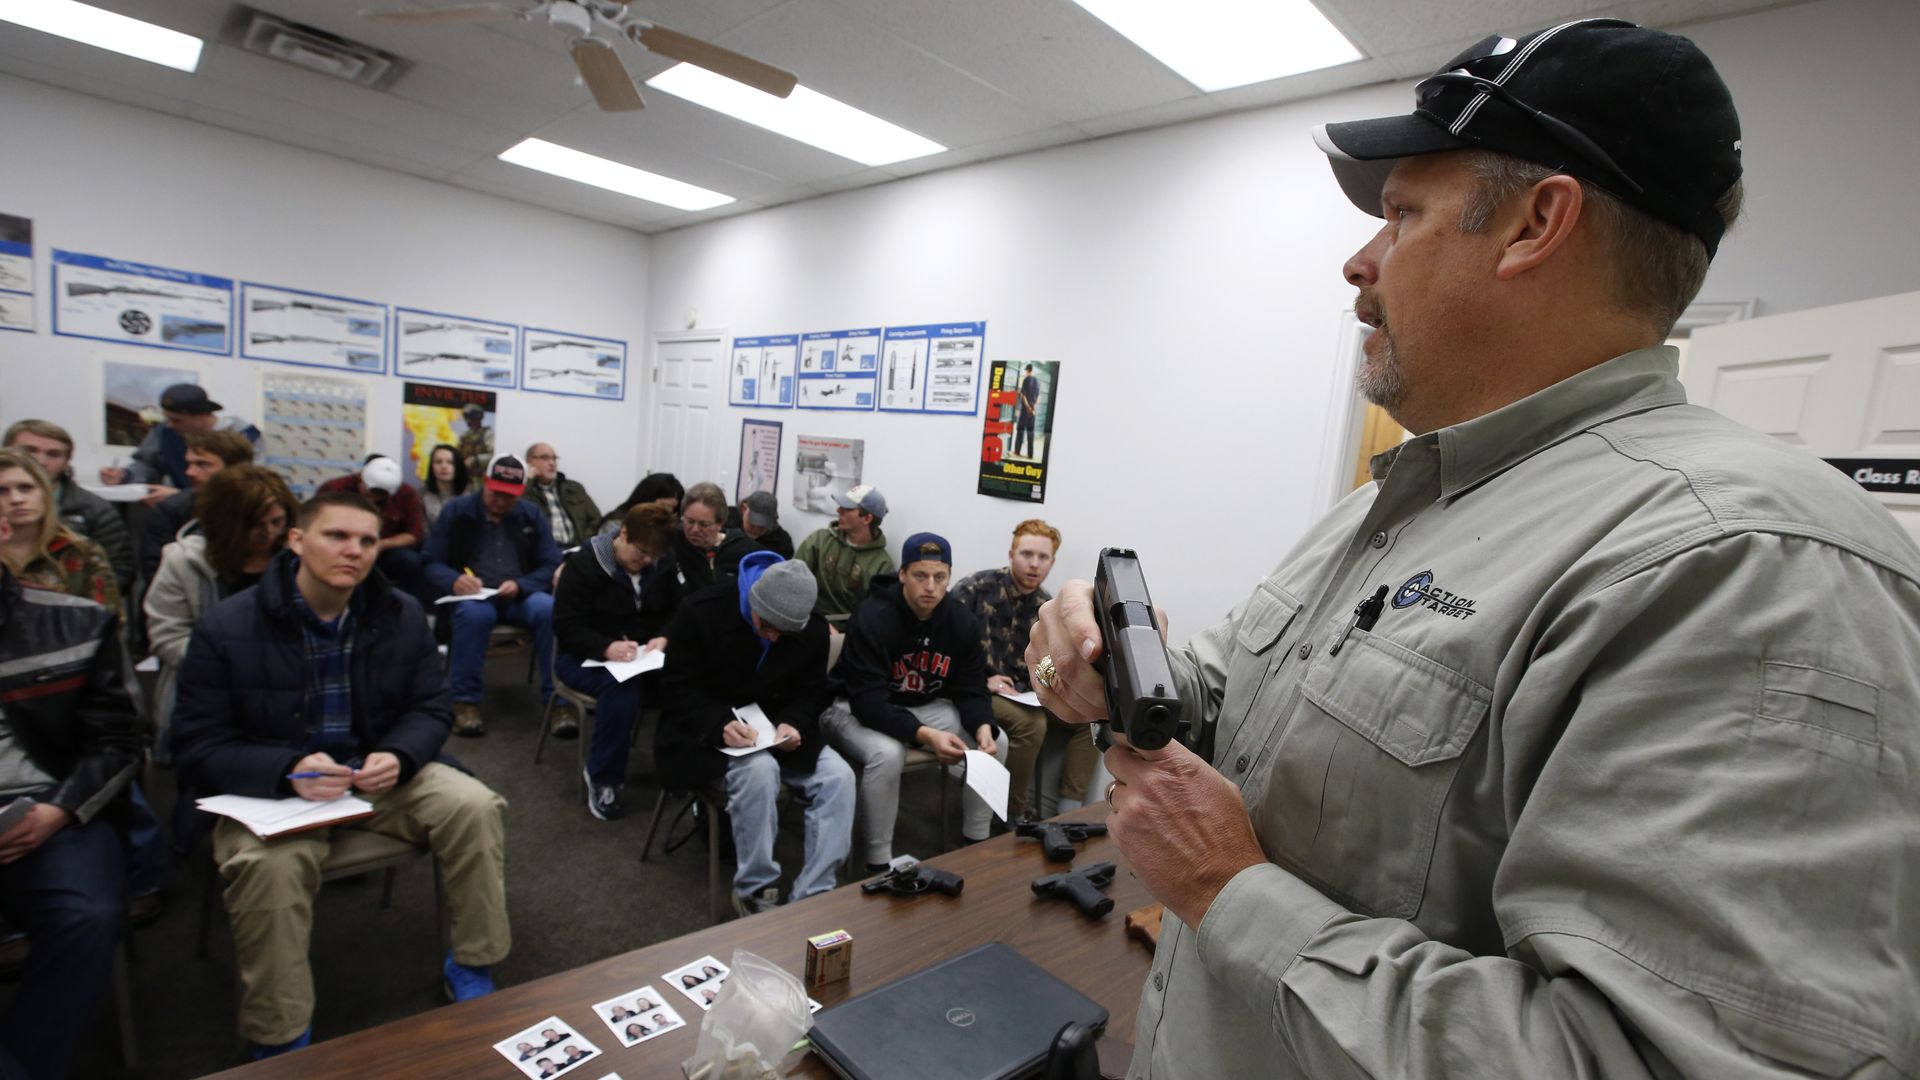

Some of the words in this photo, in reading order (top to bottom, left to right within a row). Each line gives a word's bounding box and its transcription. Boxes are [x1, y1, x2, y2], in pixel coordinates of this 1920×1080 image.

[991, 367, 1004, 398] Don't
[1003, 463, 1026, 476] Other
[1025, 465, 1043, 480] Guy
[1853, 467, 1902, 485] Class
[1904, 469, 1920, 486] R
[1420, 584, 1477, 609] ACTION
[1420, 597, 1474, 621] TARGET
[891, 650, 951, 679] UTAH
